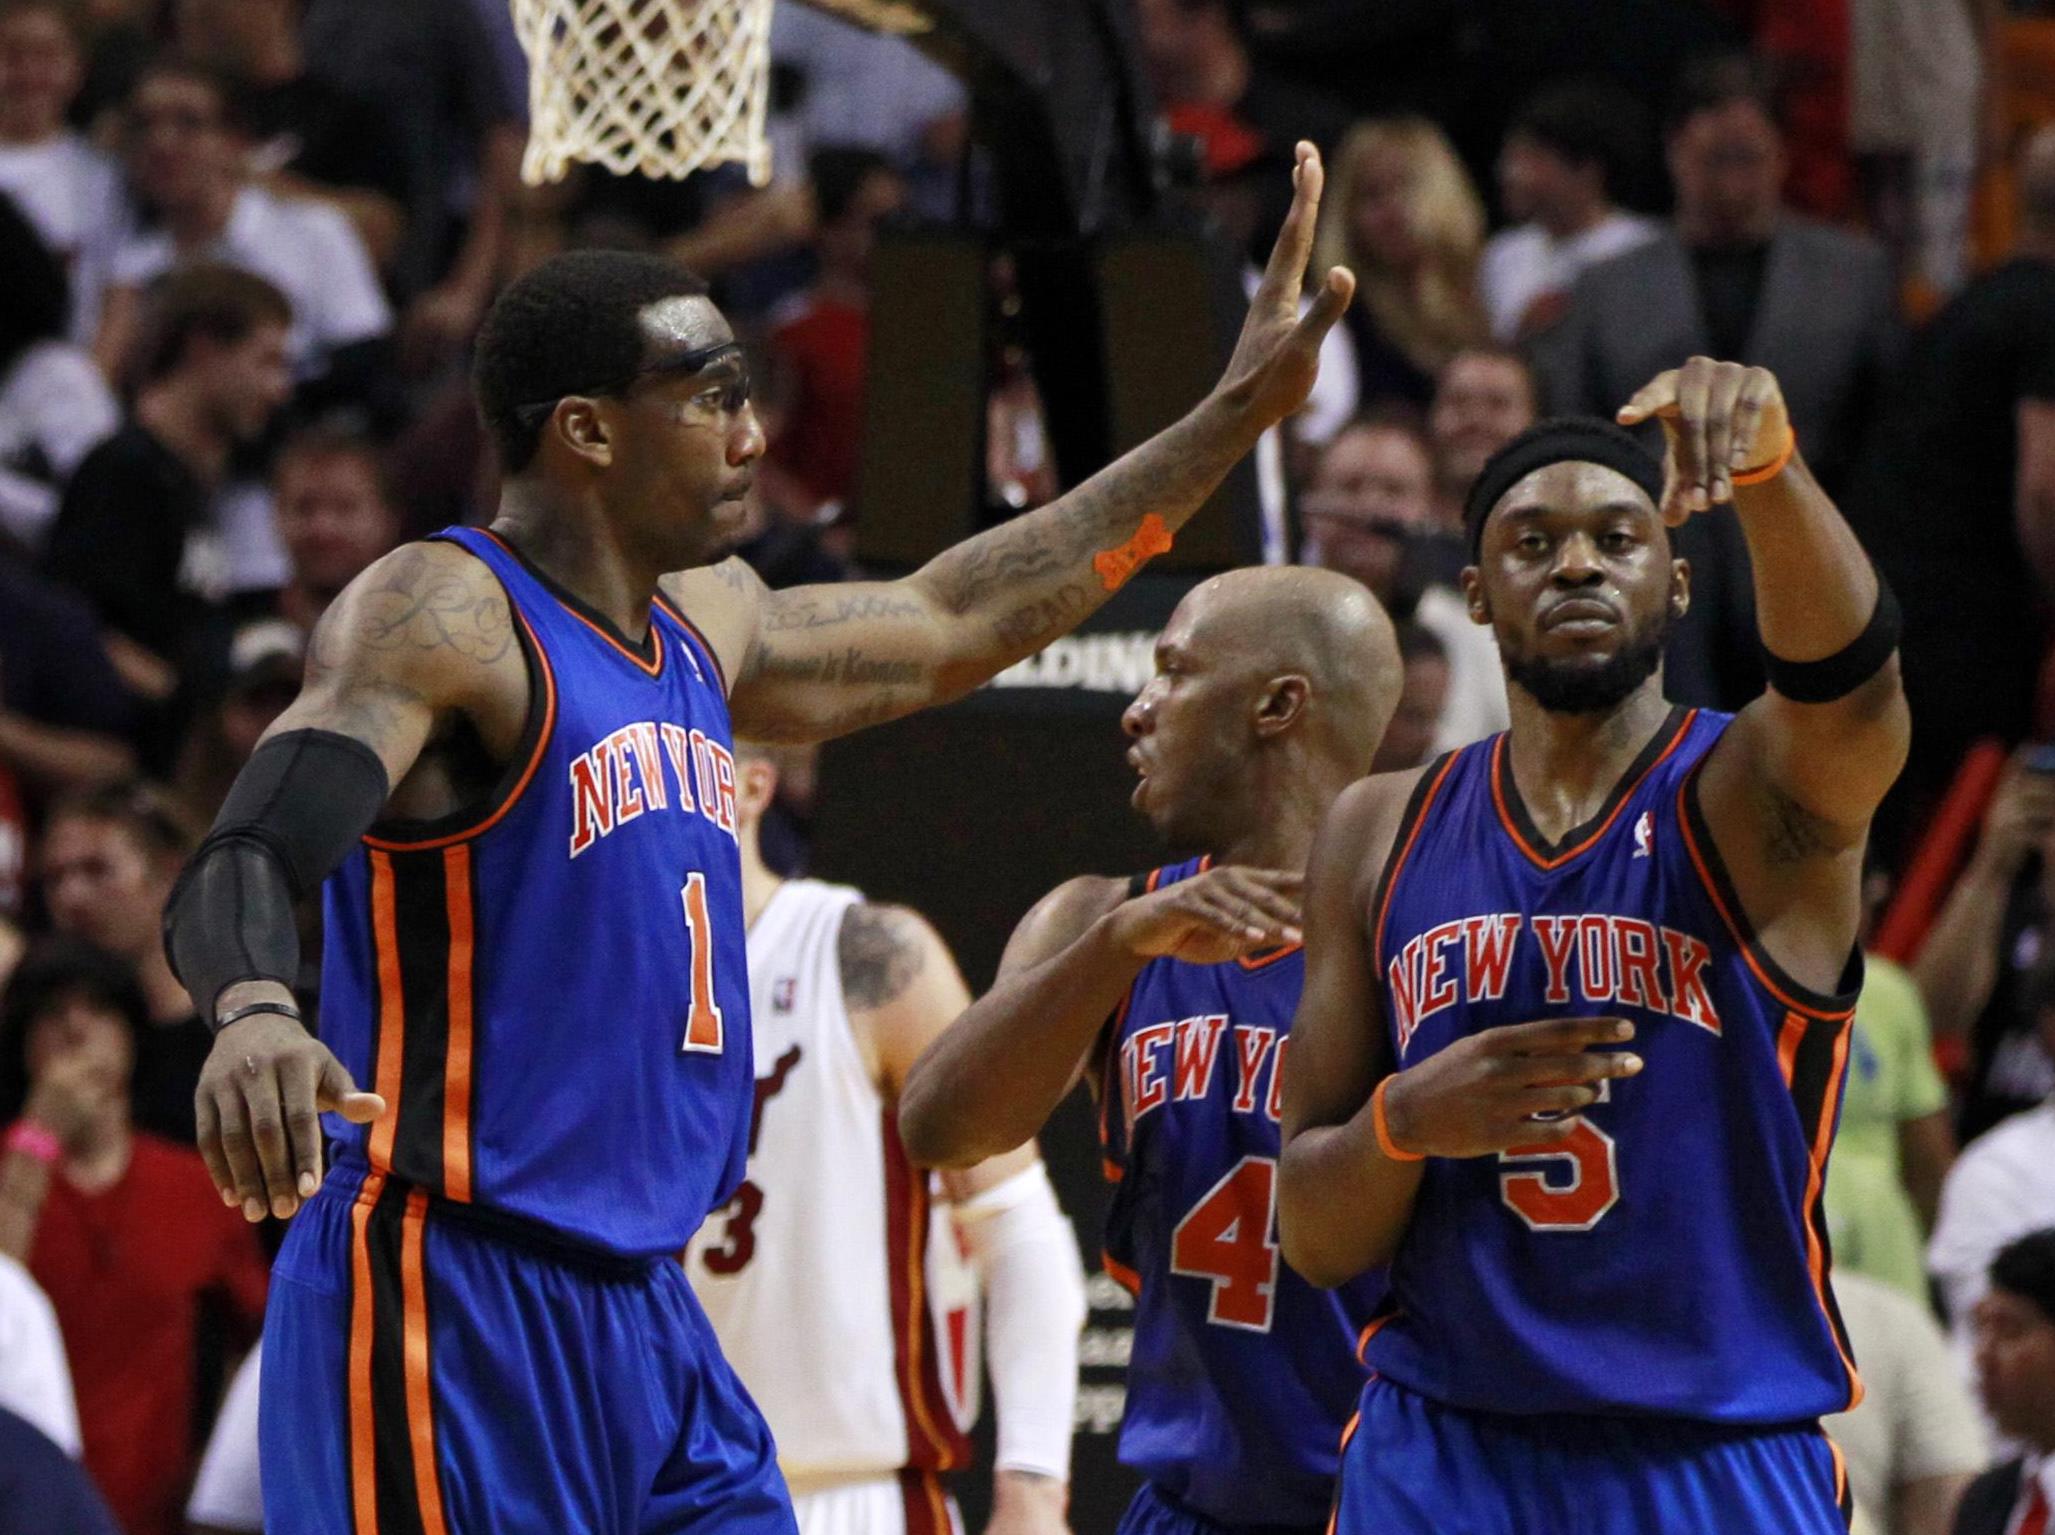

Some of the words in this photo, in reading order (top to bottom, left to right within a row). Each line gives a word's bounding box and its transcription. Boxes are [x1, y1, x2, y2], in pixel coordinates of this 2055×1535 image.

[569, 721, 669, 860] NEW
[660, 721, 739, 848] YOR
[680, 871, 723, 1055] 1
[1389, 913, 1523, 1060] NEW
[1530, 914, 1723, 1037] YORK
[676, 1179, 764, 1276] 3
[1498, 1078, 1621, 1232] 5
[1170, 1155, 1279, 1334] 4
